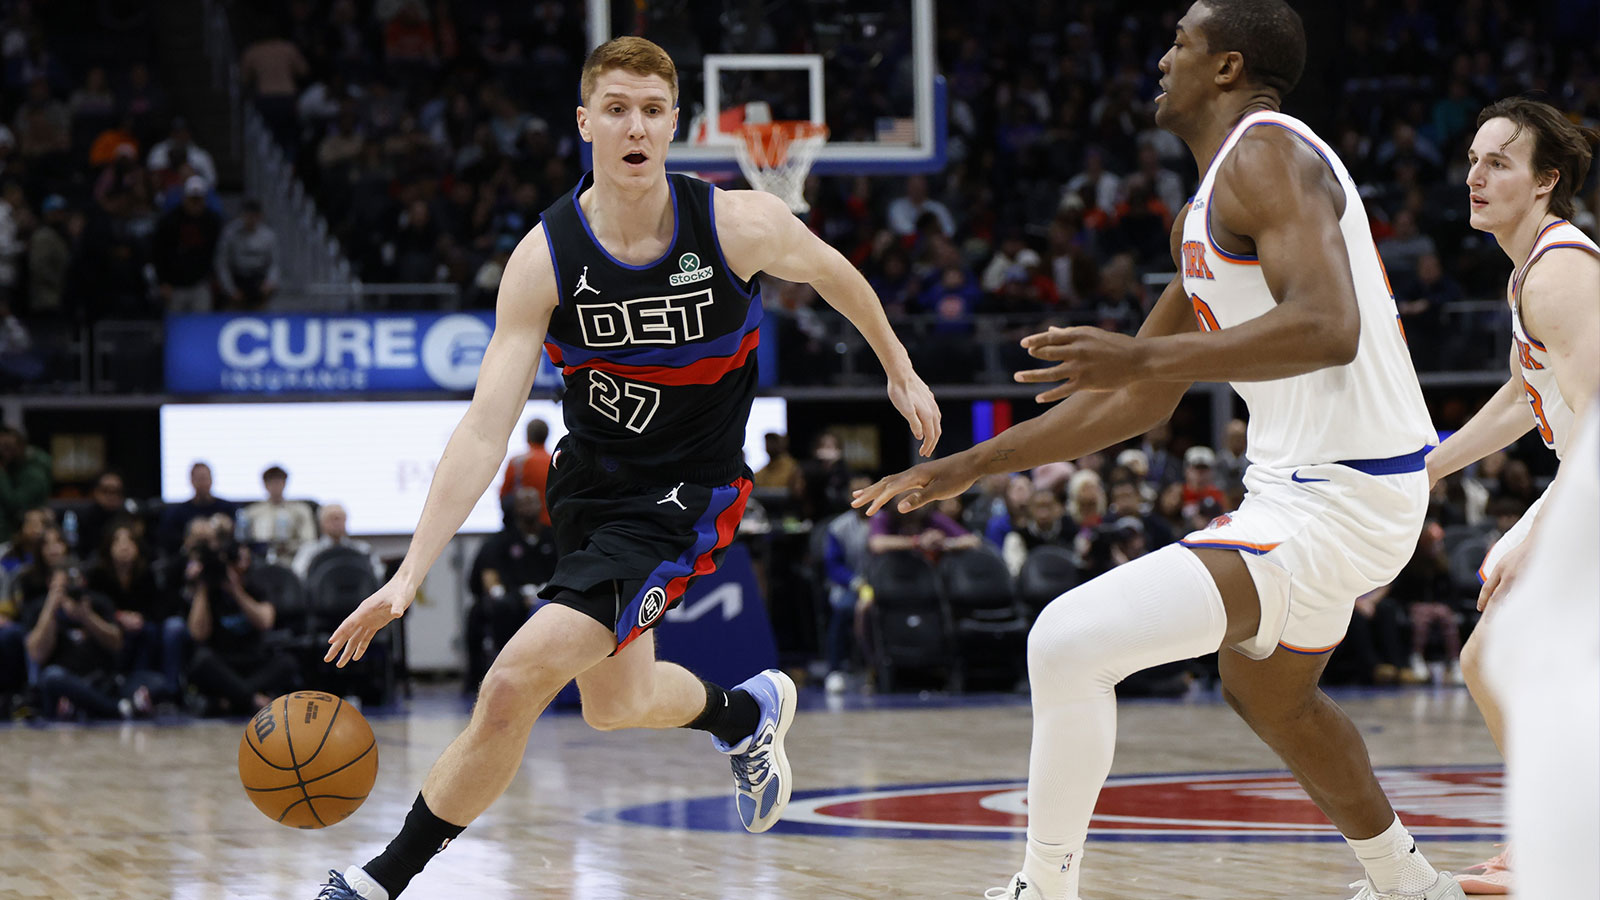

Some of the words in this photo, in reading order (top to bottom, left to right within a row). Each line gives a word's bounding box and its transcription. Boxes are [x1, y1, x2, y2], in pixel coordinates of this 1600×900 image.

[671, 268, 712, 284] StockX
[218, 317, 417, 368] CURE
[576, 288, 714, 347] DET
[221, 370, 369, 390] INSURANCE
[589, 369, 661, 434] 27
